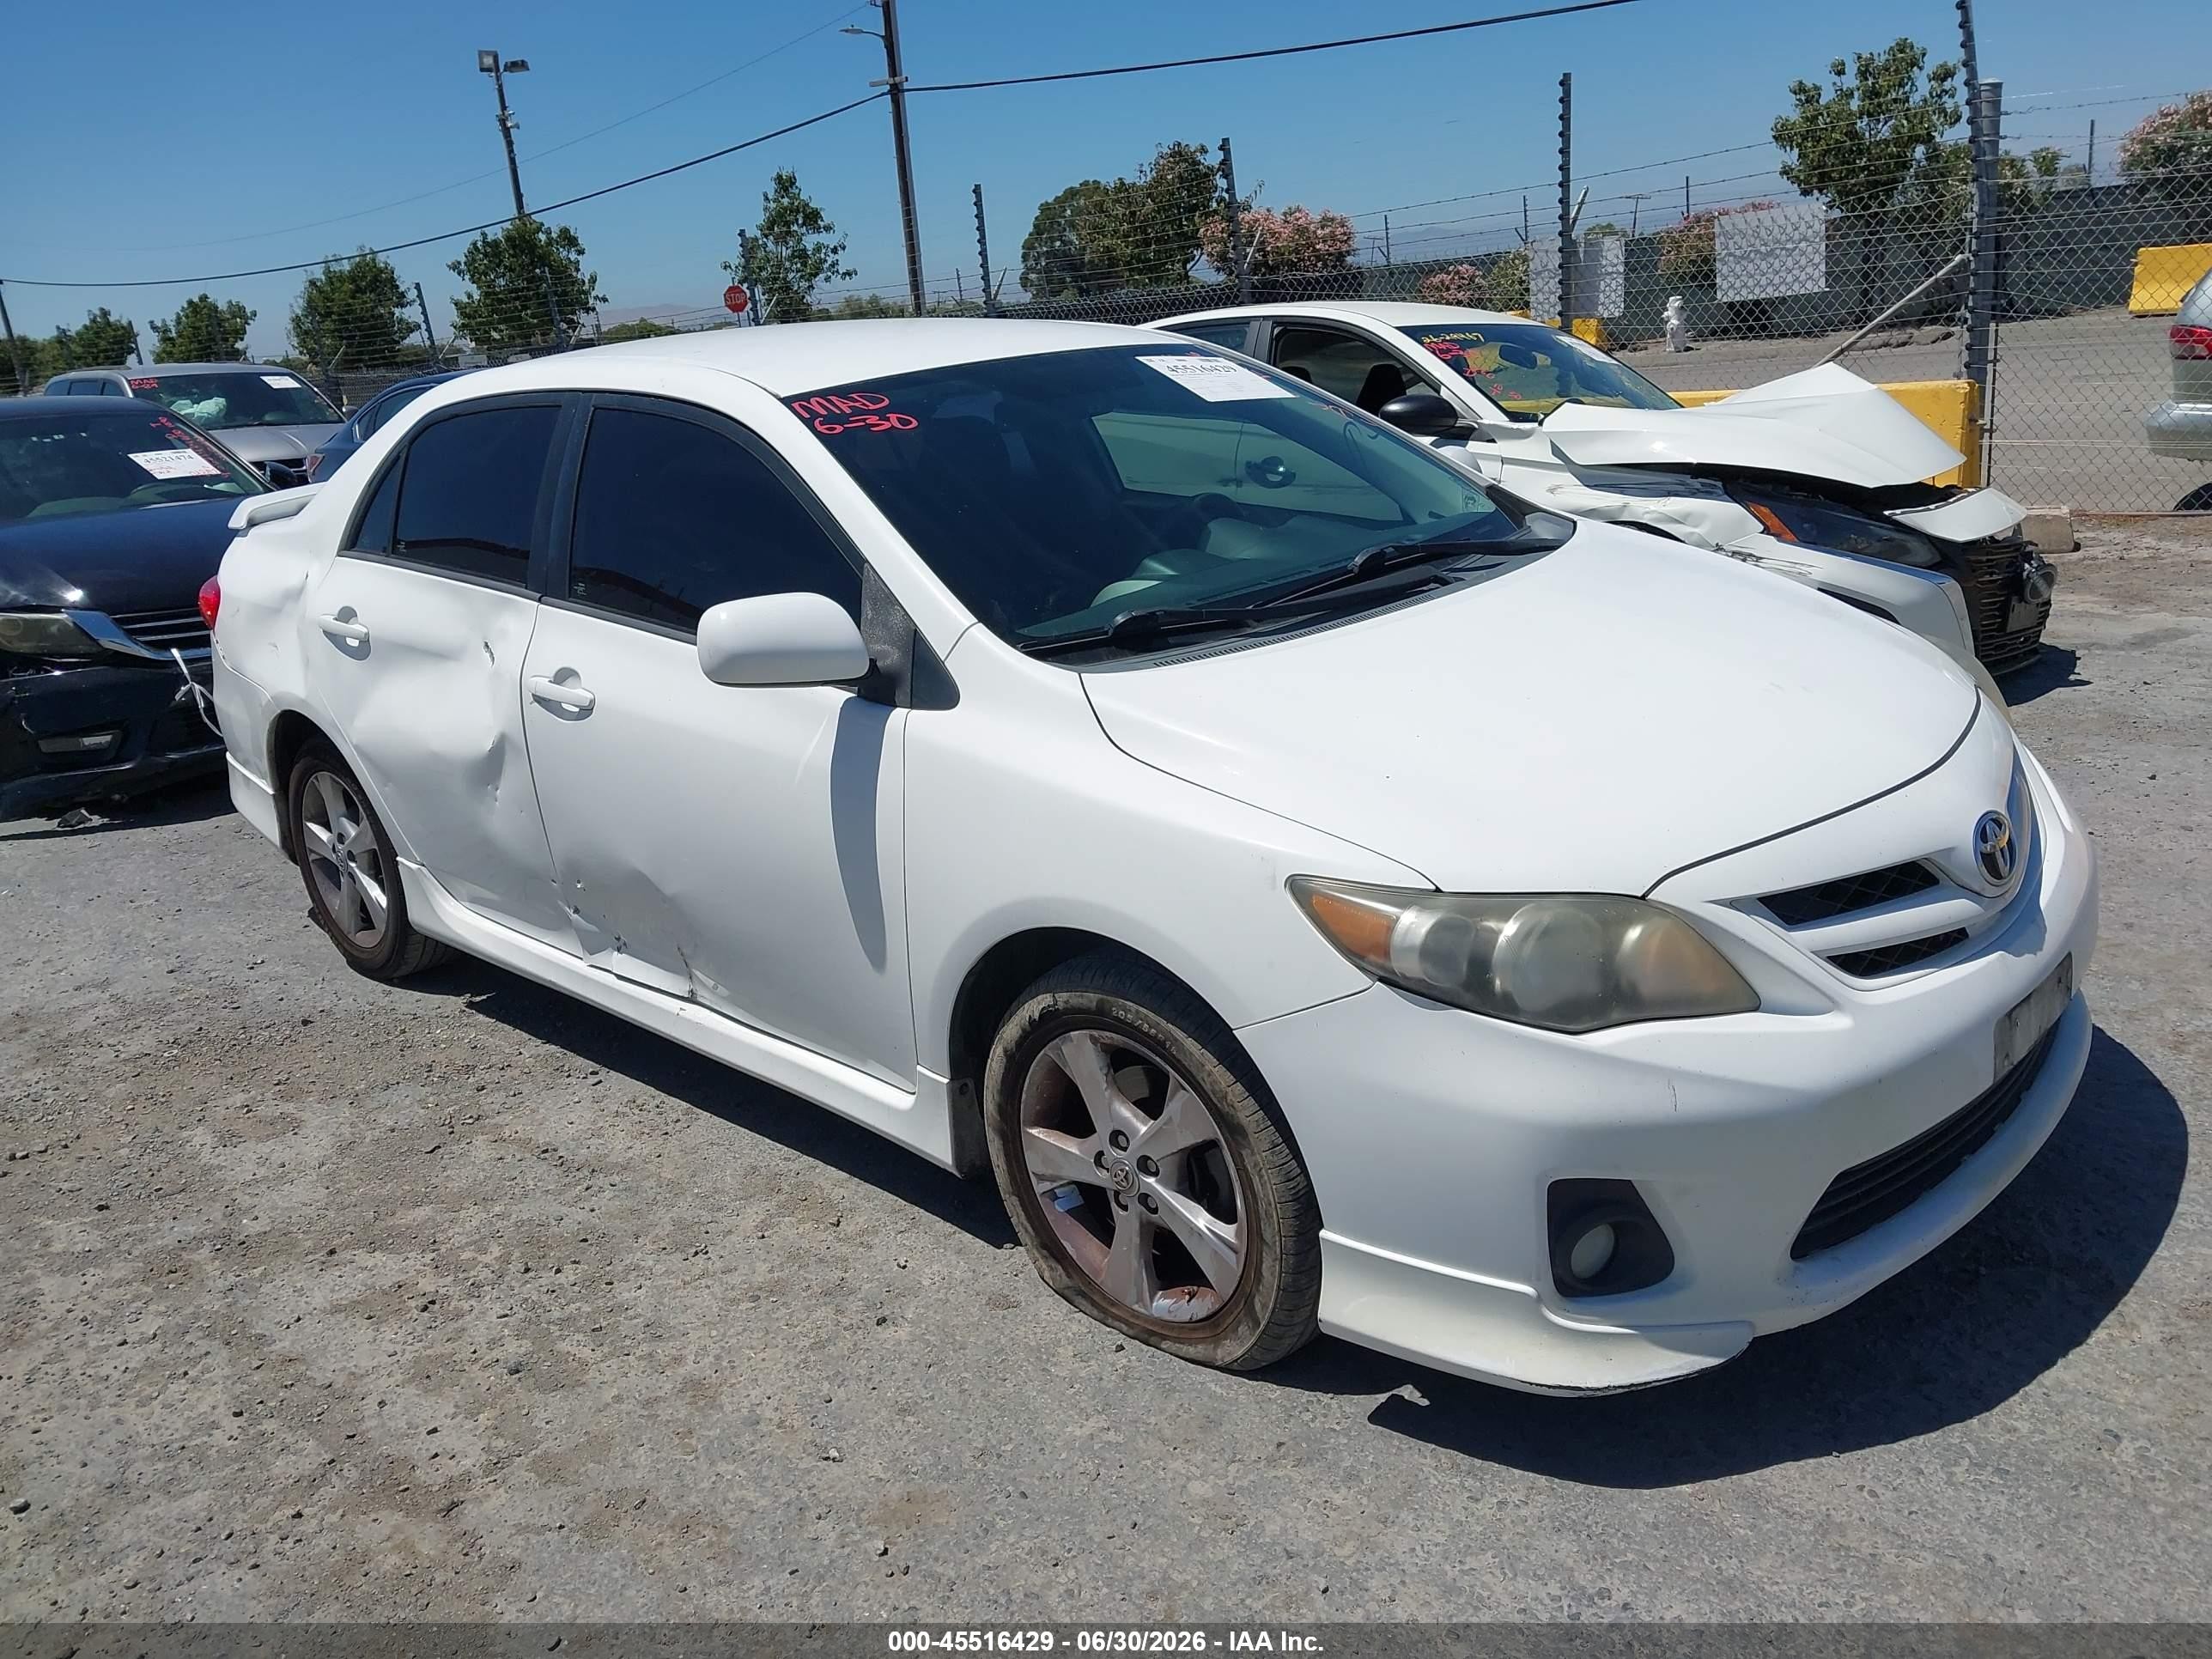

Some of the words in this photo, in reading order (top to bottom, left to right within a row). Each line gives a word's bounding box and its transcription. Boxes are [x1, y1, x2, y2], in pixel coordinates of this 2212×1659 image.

[726, 293, 746, 304] STOP
[1166, 364, 1237, 374] 45516429
[790, 392, 890, 418] MAD
[814, 413, 919, 434] 6-30
[143, 453, 195, 465] 45521474
